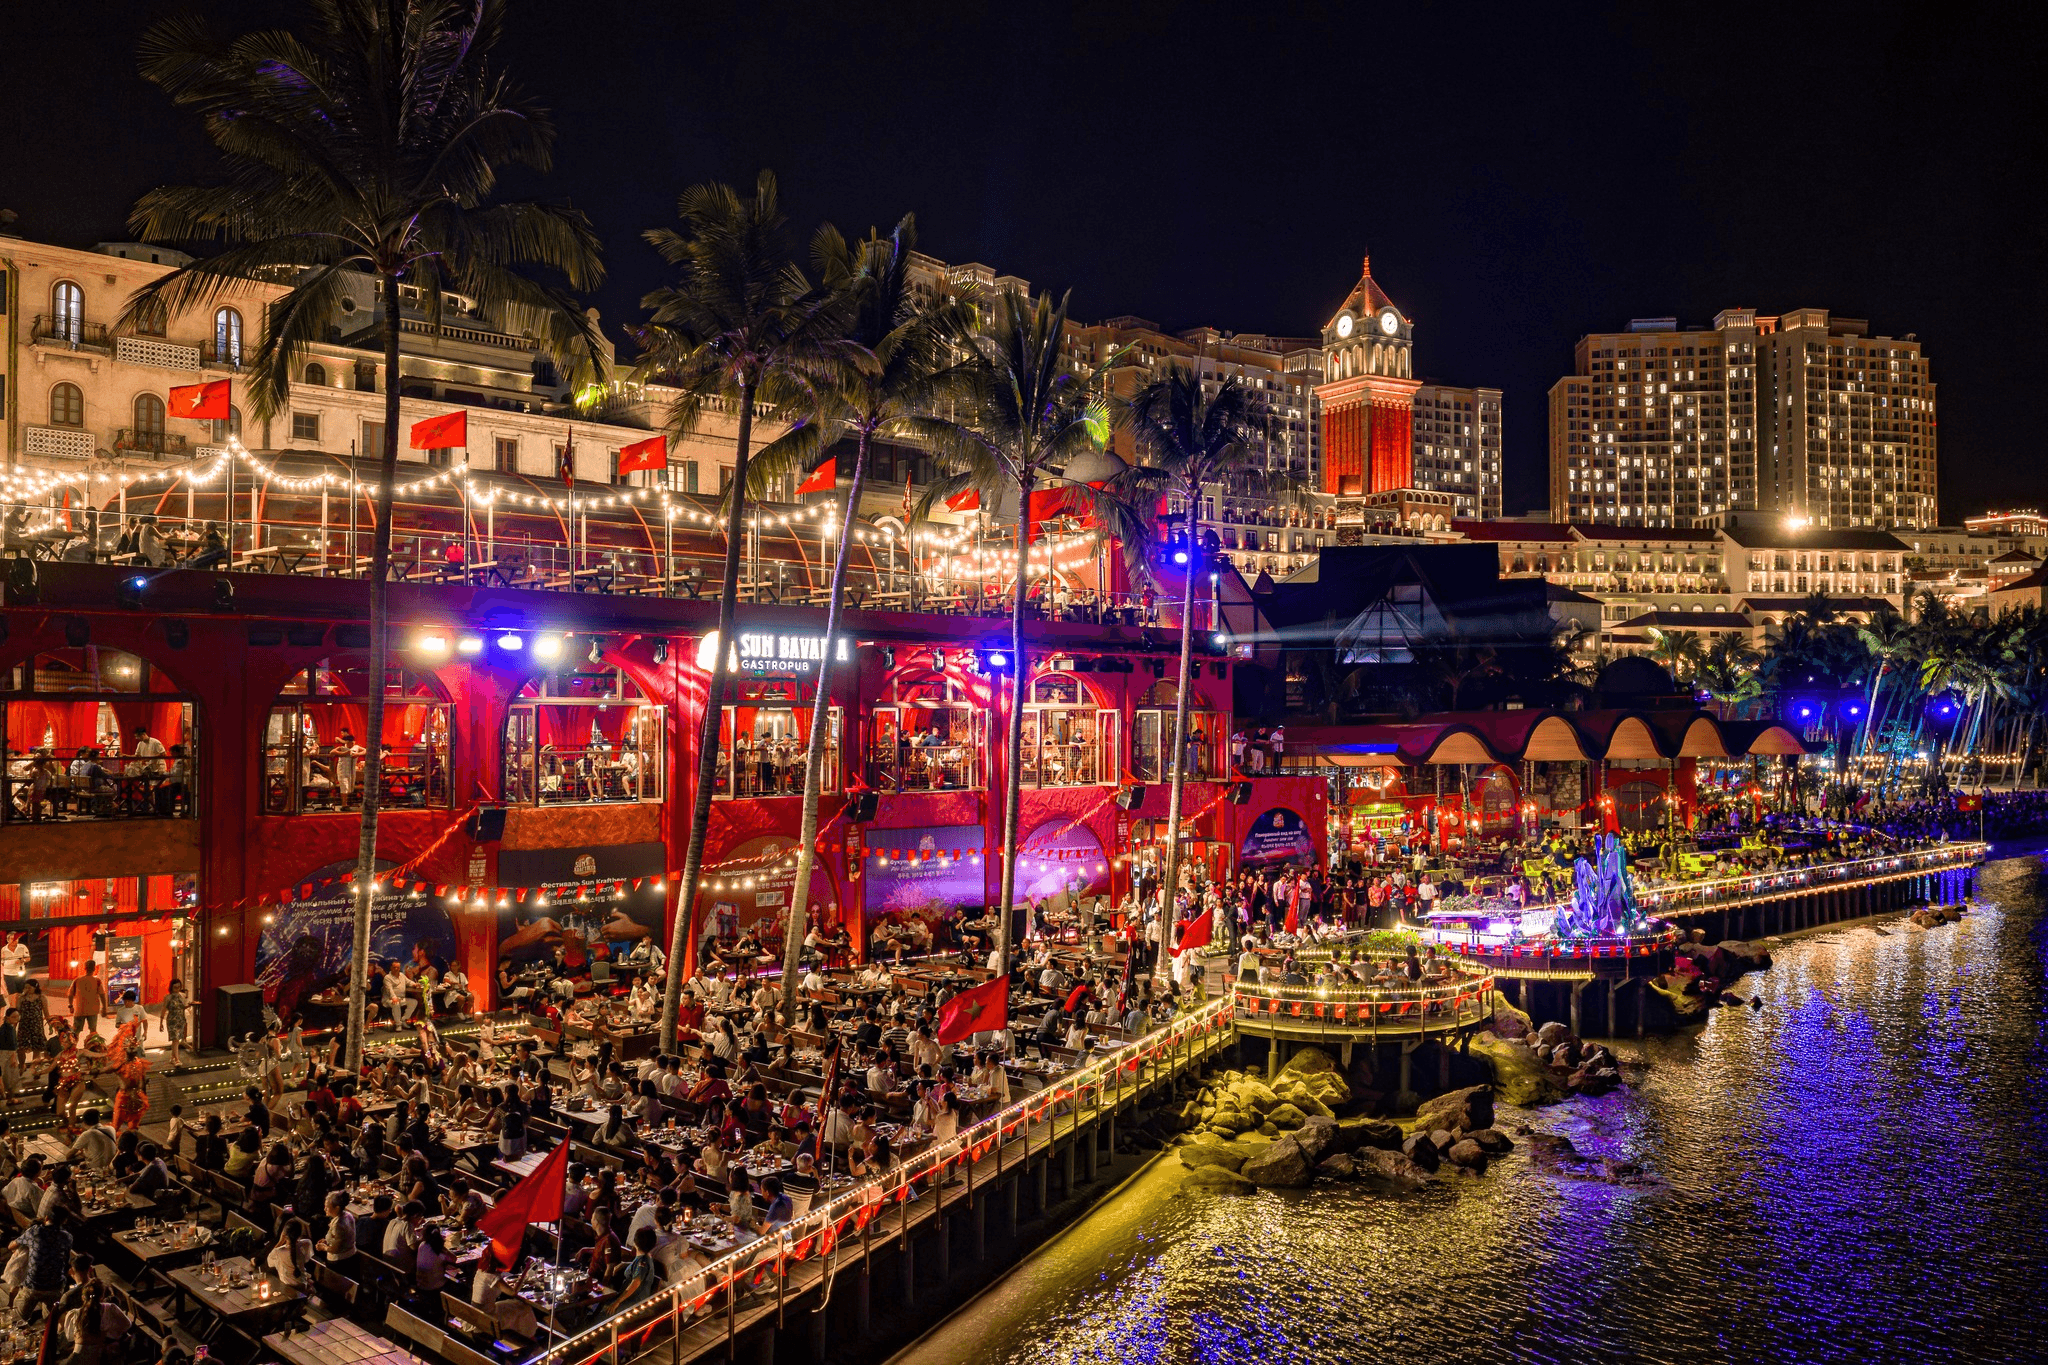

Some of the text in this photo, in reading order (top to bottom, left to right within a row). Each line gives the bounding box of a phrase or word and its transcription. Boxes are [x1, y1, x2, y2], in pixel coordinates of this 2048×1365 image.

[741, 633, 848, 661] SUN BAVAA
[741, 659, 810, 671] GASTROPUB
[541, 881, 581, 889] Фестиваль
[407, 892, 428, 901] мря
[399, 902, 413, 910] THE
